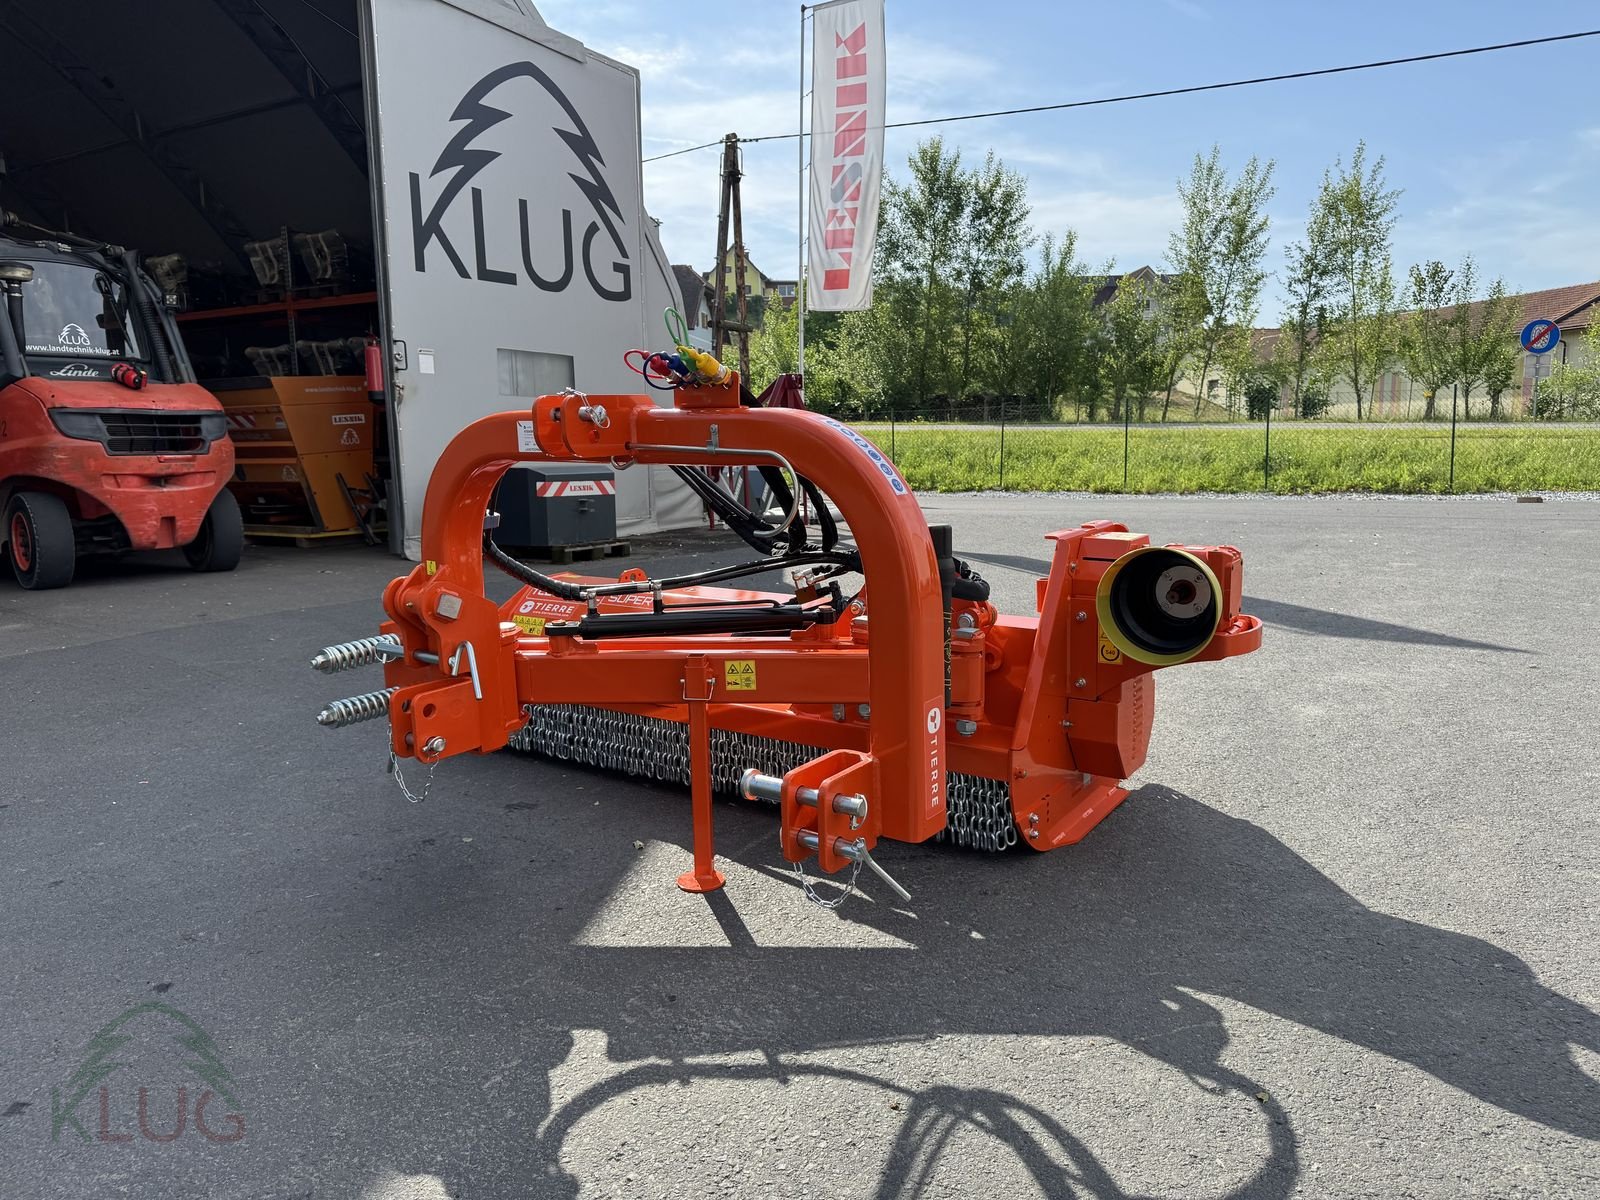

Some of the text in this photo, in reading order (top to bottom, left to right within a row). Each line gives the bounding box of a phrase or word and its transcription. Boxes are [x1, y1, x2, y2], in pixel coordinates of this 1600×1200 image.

[823, 22, 868, 290] LESNIK
[409, 170, 632, 302] KLUG
[58, 334, 91, 346] KLUG
[26, 344, 120, 356] www.landtechnik-klug.at
[50, 363, 99, 377] Linde
[607, 594, 654, 606] SUPER
[535, 602, 574, 614] TIERRE
[930, 734, 939, 808] TIERRE
